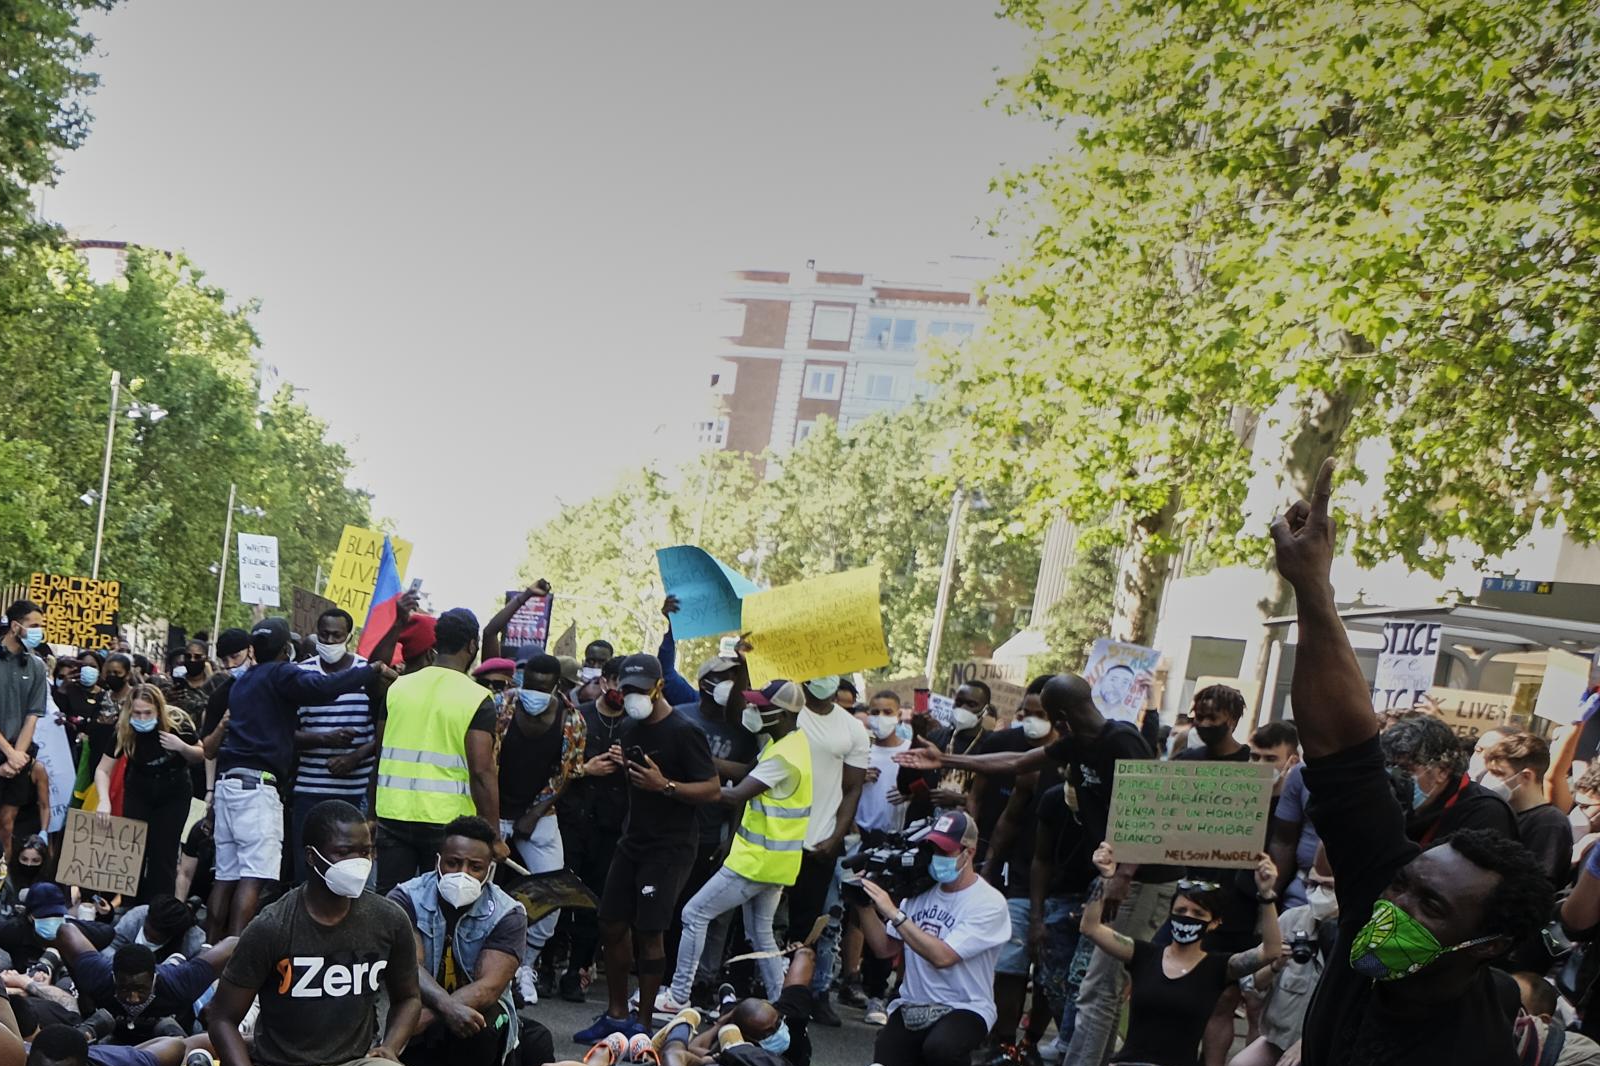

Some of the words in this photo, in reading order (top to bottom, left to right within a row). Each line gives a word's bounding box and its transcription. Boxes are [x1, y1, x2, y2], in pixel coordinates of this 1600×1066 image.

[245, 543, 272, 554] WHITE
[241, 556, 276, 569] SILENCE
[339, 560, 380, 587] LIVE
[329, 584, 372, 612] MATT
[82, 609, 114, 626] QUE
[951, 661, 977, 685] NO
[1456, 701, 1509, 721] LIVES
[1220, 782, 1263, 794] COMO
[72, 813, 145, 855] BLACK
[1197, 824, 1255, 837] HOMBRE
[71, 845, 134, 875] LIVES
[1165, 850, 1210, 861] NELSON
[63, 864, 137, 894] MATTER
